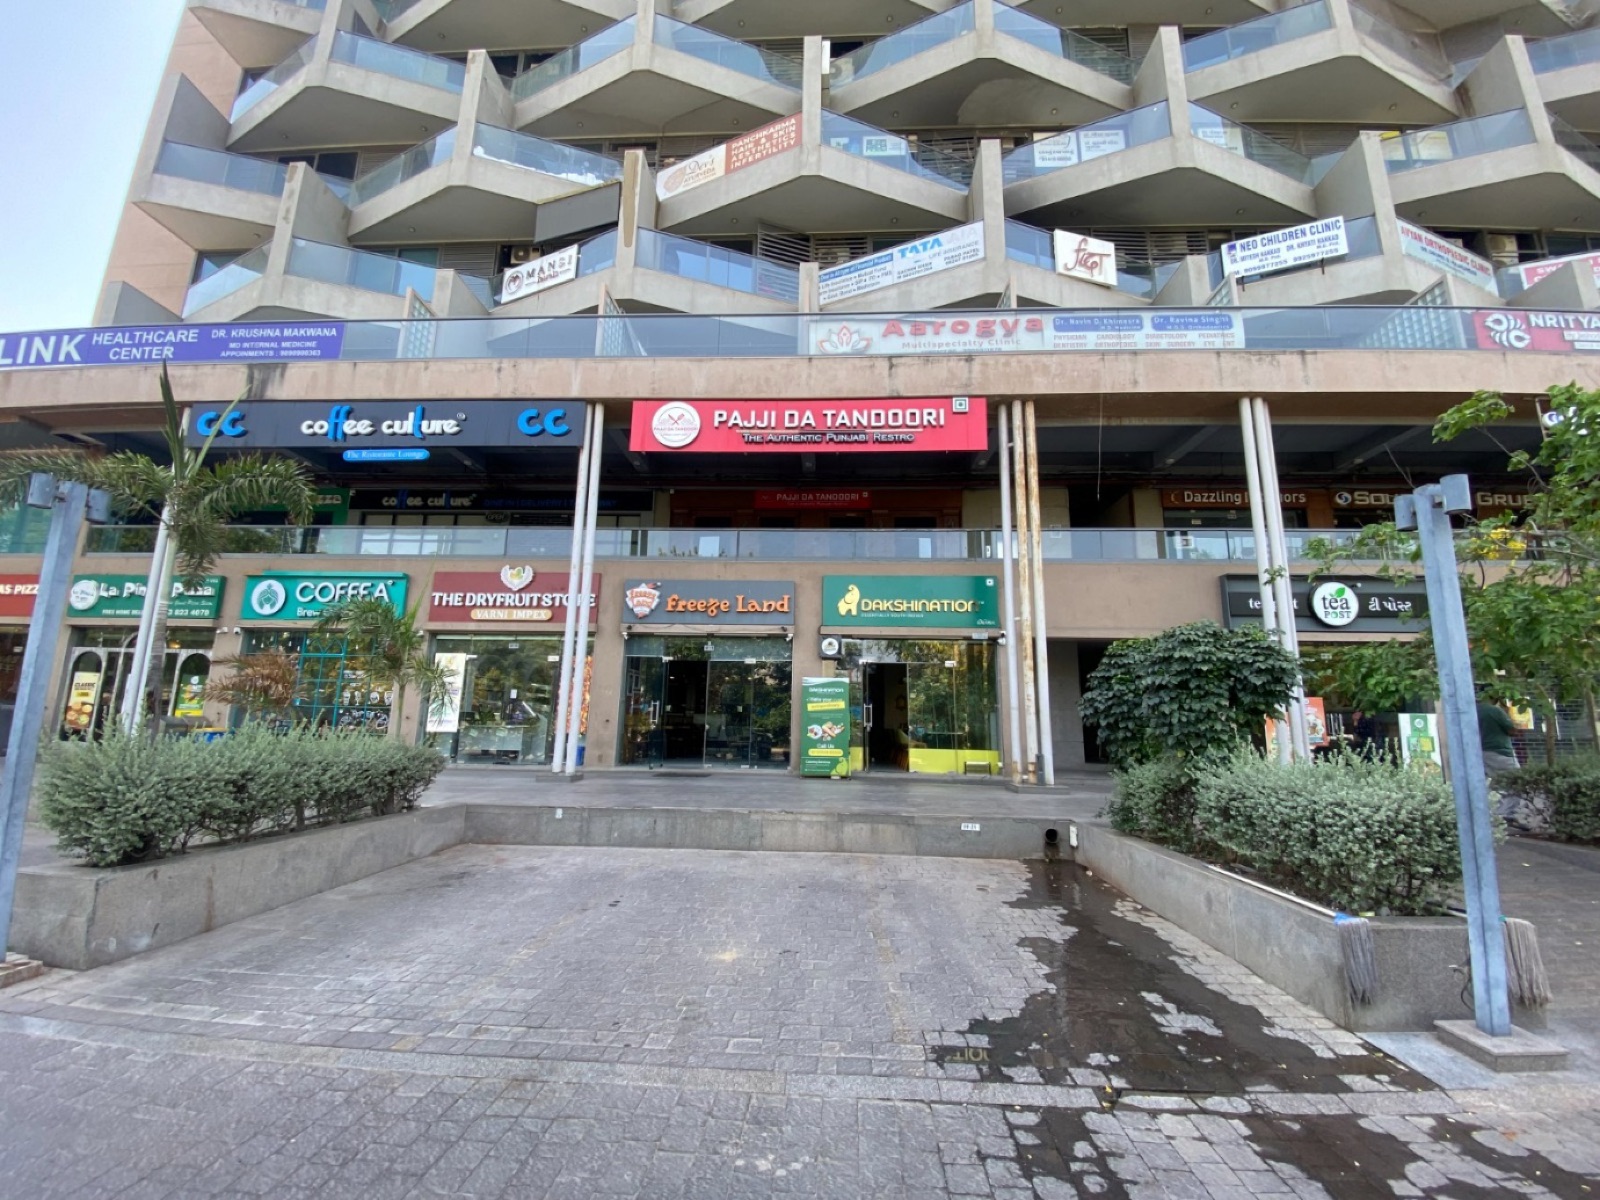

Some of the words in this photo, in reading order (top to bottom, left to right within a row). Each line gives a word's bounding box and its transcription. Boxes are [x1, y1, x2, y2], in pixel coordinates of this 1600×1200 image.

[731, 132, 797, 162] AESTHETICS
[732, 140, 755, 156] HAIR
[772, 125, 796, 139] SKIN
[731, 138, 796, 170] INFERTILITY
[1239, 239, 1258, 252] NEO
[1261, 227, 1308, 248] CHILDREN
[1309, 219, 1342, 236] CLINIC
[897, 237, 944, 259] TATA
[525, 254, 574, 280] MANSI
[881, 317, 1044, 338] Aarogya
[1055, 318, 1067, 326] Dr.
[92, 328, 200, 346] HEALTHCARE
[211, 328, 228, 339] DR.
[231, 327, 281, 338] KRUSHNA
[283, 327, 338, 338] MAKWANA
[1096, 333, 1136, 341] CARDIOLOGY
[242, 341, 279, 349] INTERNAL
[281, 340, 318, 348] MEDICINE
[988, 338, 1021, 347] Clinic
[1053, 341, 1088, 349] DENTISTRY
[109, 345, 175, 361] CENTER
[300, 405, 376, 441] coffee
[381, 404, 463, 440] culture
[713, 409, 777, 429] PAJJI
[784, 409, 817, 429] DA
[822, 408, 945, 428] TANDOORI
[776, 493, 800, 501] PAJJI
[801, 493, 814, 501] DA
[815, 492, 859, 500] TANDOORI
[1184, 490, 1243, 505] Dazzling
[14, 584, 40, 595] PIZZ
[100, 583, 120, 597] La
[432, 591, 464, 607] THE
[465, 591, 541, 607] DRYFRUIT
[735, 593, 792, 613] Land
[1321, 594, 1350, 610] tea
[476, 609, 508, 620] VARNI
[513, 609, 548, 620] IMPEX
[1324, 610, 1352, 619] POST
